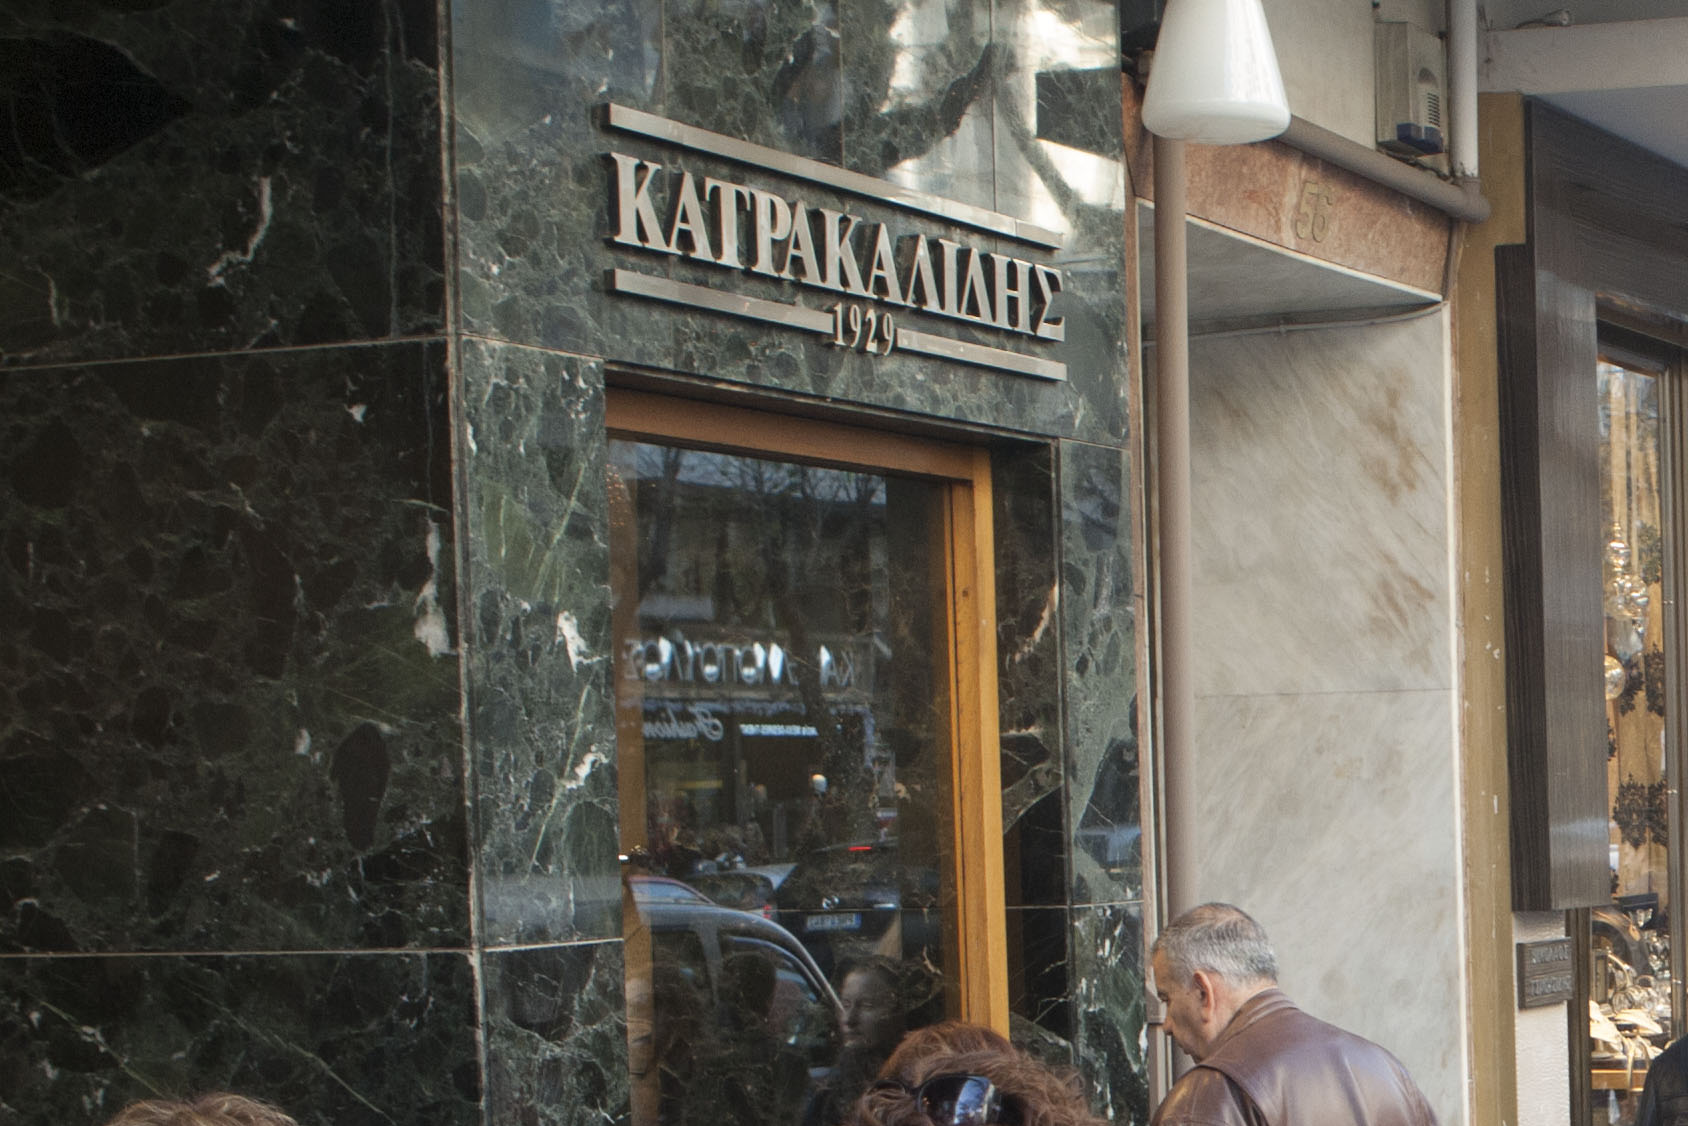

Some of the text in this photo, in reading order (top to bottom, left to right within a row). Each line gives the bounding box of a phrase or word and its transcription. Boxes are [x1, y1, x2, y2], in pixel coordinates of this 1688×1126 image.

[1296, 181, 1332, 243] 56
[609, 151, 1065, 341] ΚΑΤΡΑΚΑΛΙΔΗΣ
[833, 303, 894, 356] 1929
